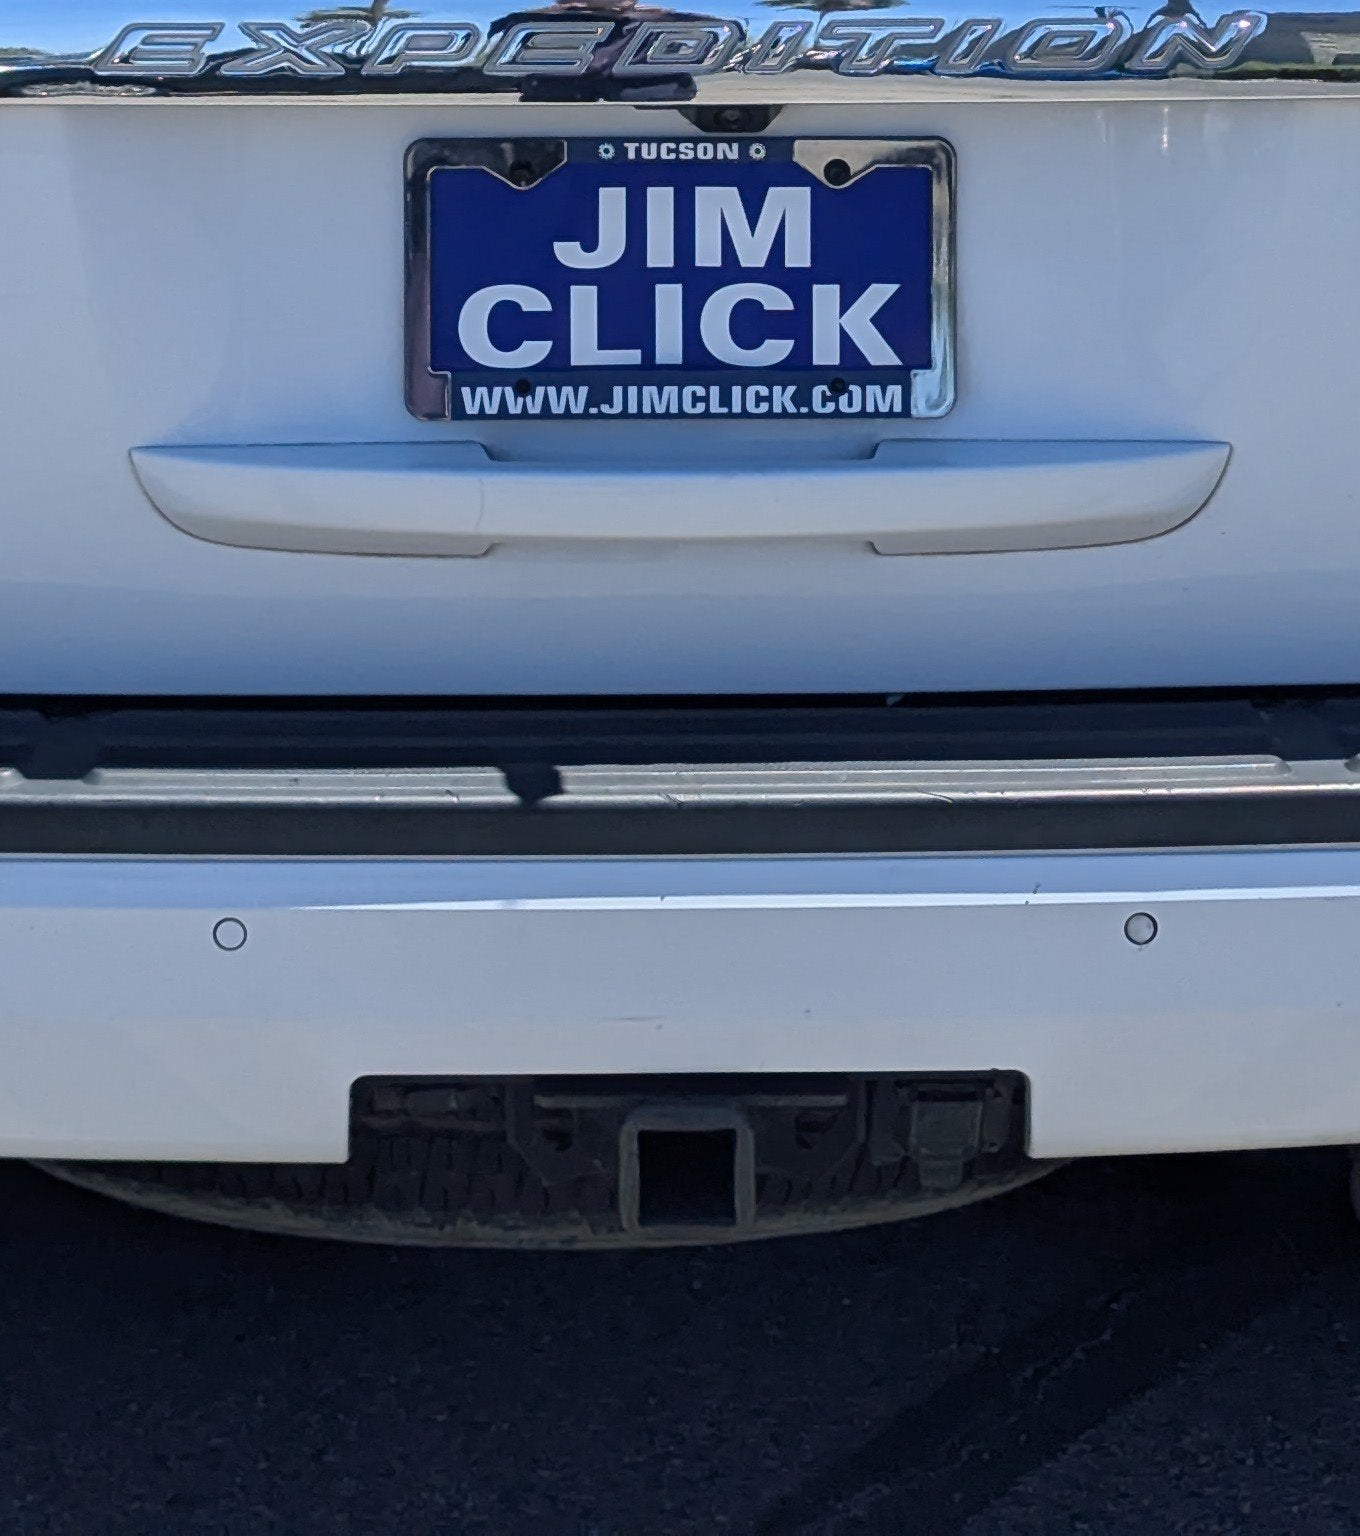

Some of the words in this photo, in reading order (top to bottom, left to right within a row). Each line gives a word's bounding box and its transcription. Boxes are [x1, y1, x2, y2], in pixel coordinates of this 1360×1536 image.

[90, 11, 1270, 77] EXPEDITION
[623, 142, 739, 161] TUCSON
[552, 186, 813, 269] JIM
[457, 282, 904, 368] CLICK
[460, 383, 904, 415] WWW.JIMCLICK.COM
